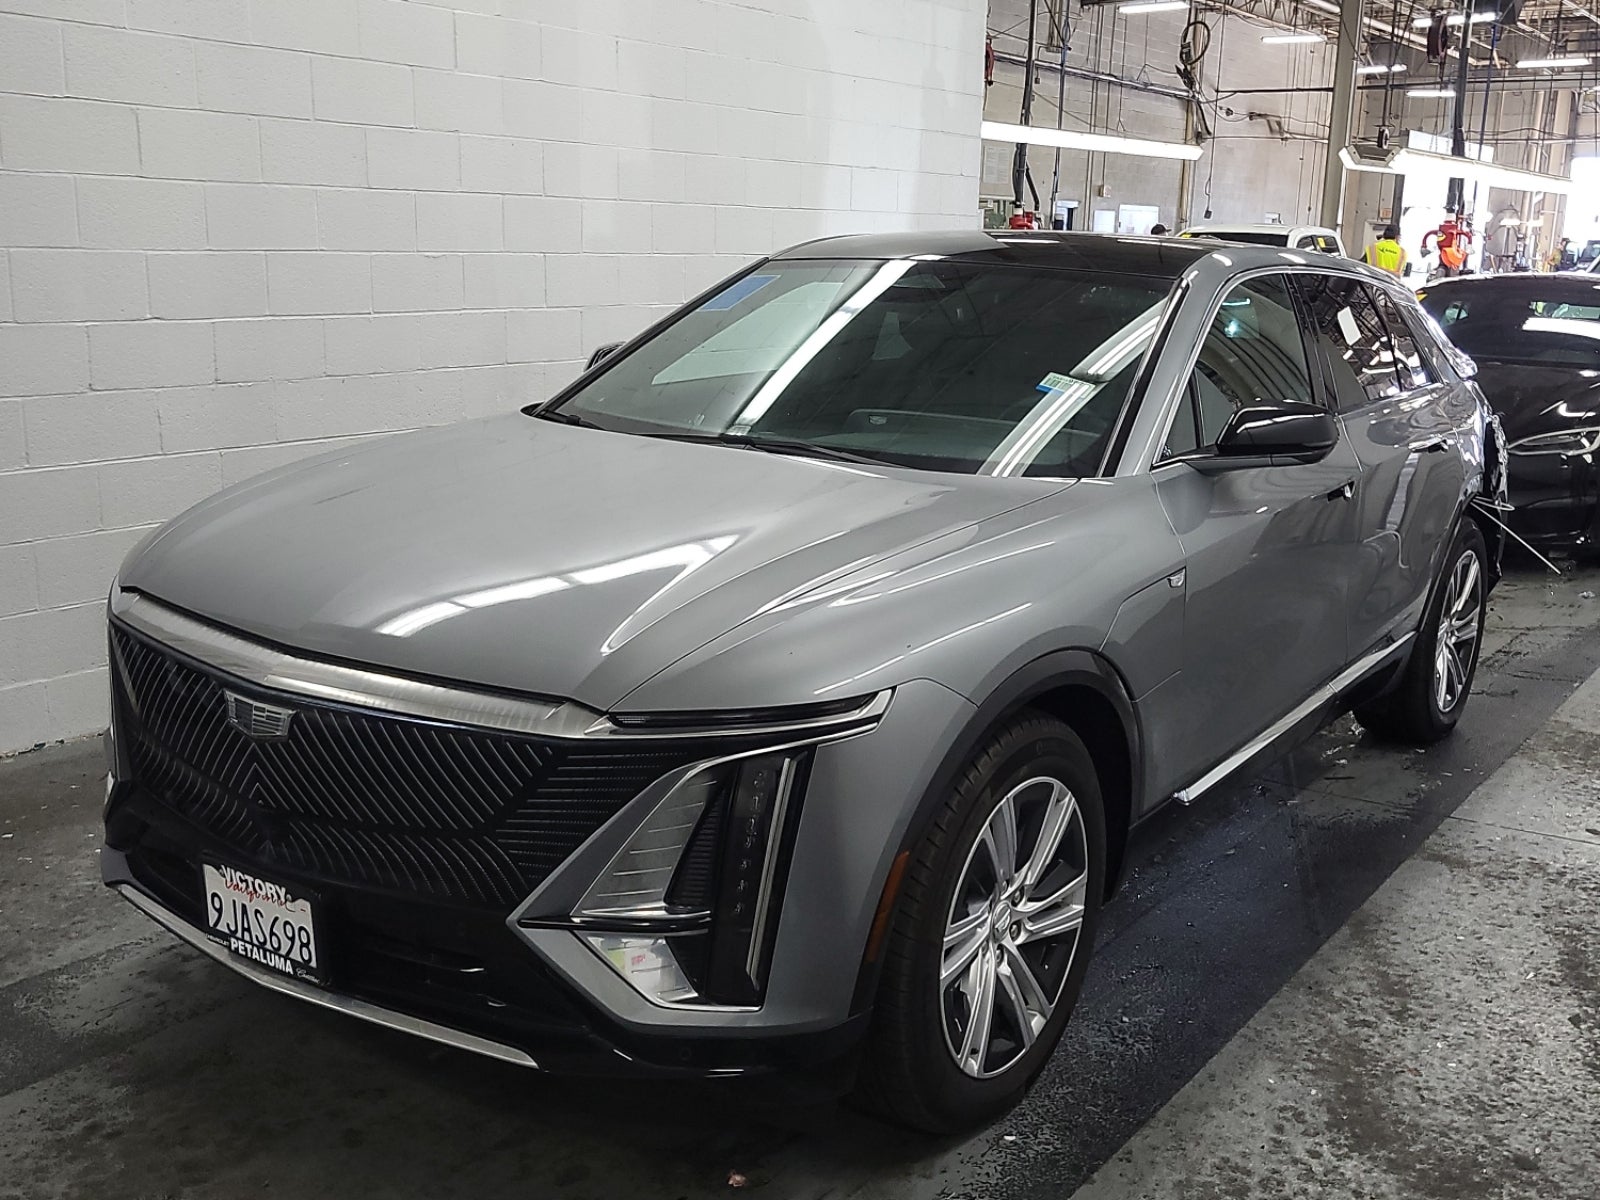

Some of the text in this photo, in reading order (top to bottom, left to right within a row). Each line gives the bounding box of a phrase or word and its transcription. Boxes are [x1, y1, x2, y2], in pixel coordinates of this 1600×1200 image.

[221, 864, 286, 902] VICTORY
[210, 891, 312, 965] 9JAS698
[230, 937, 294, 975] PETALUMA
